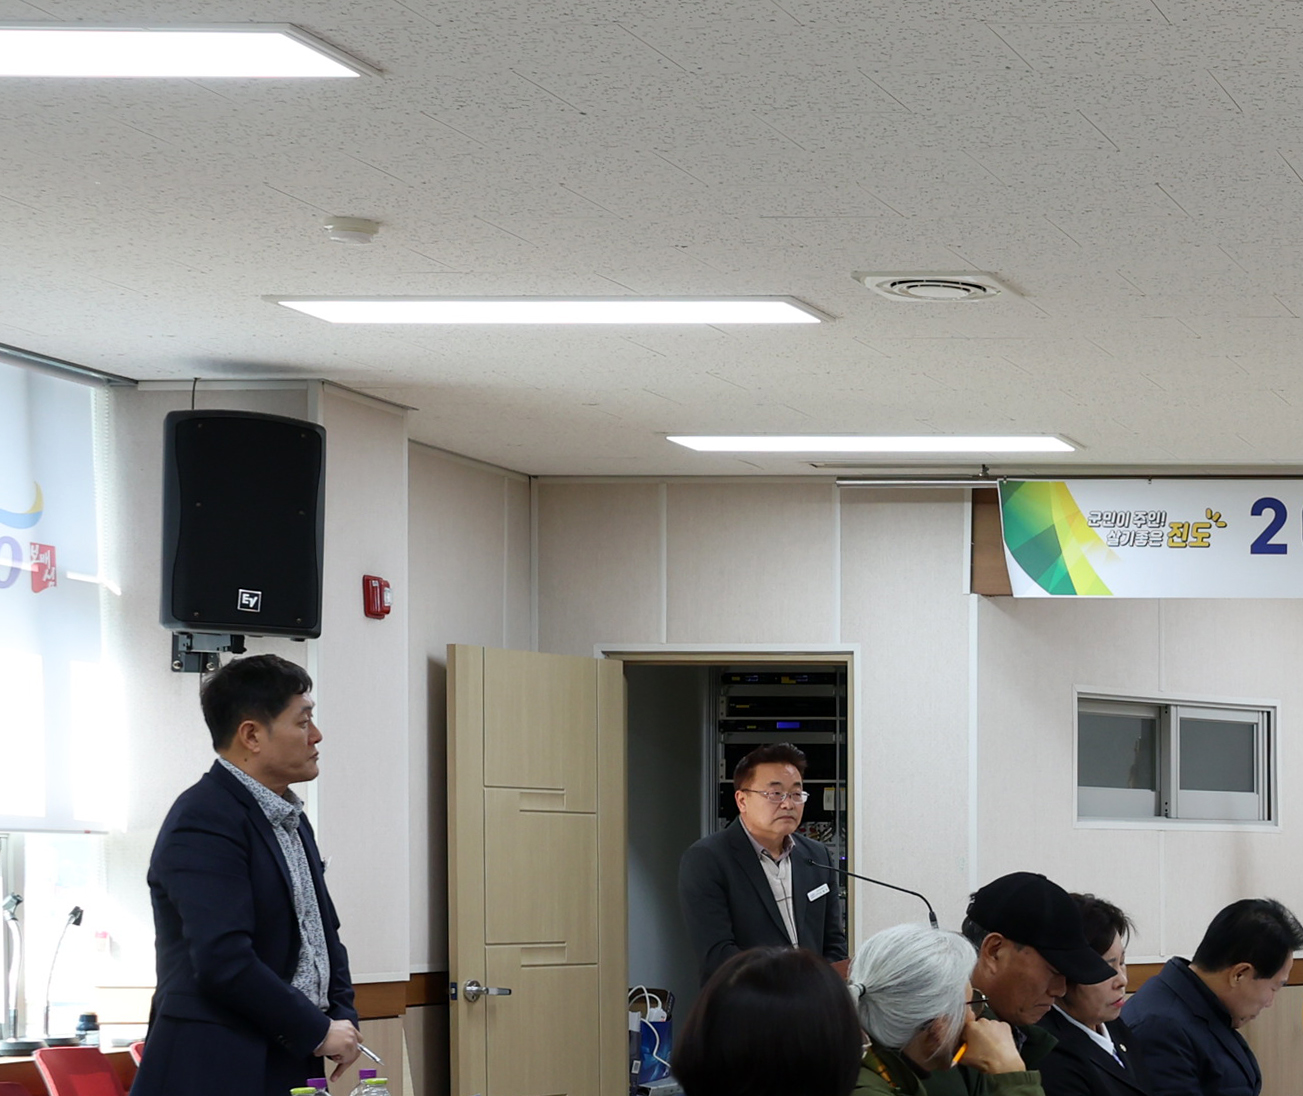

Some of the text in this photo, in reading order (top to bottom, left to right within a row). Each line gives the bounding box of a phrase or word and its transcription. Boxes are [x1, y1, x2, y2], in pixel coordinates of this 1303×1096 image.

[1087, 510, 1167, 528] 군민이 주인!
[1106, 530, 1164, 547] 살기좋은
[1167, 522, 1212, 548] 진도
